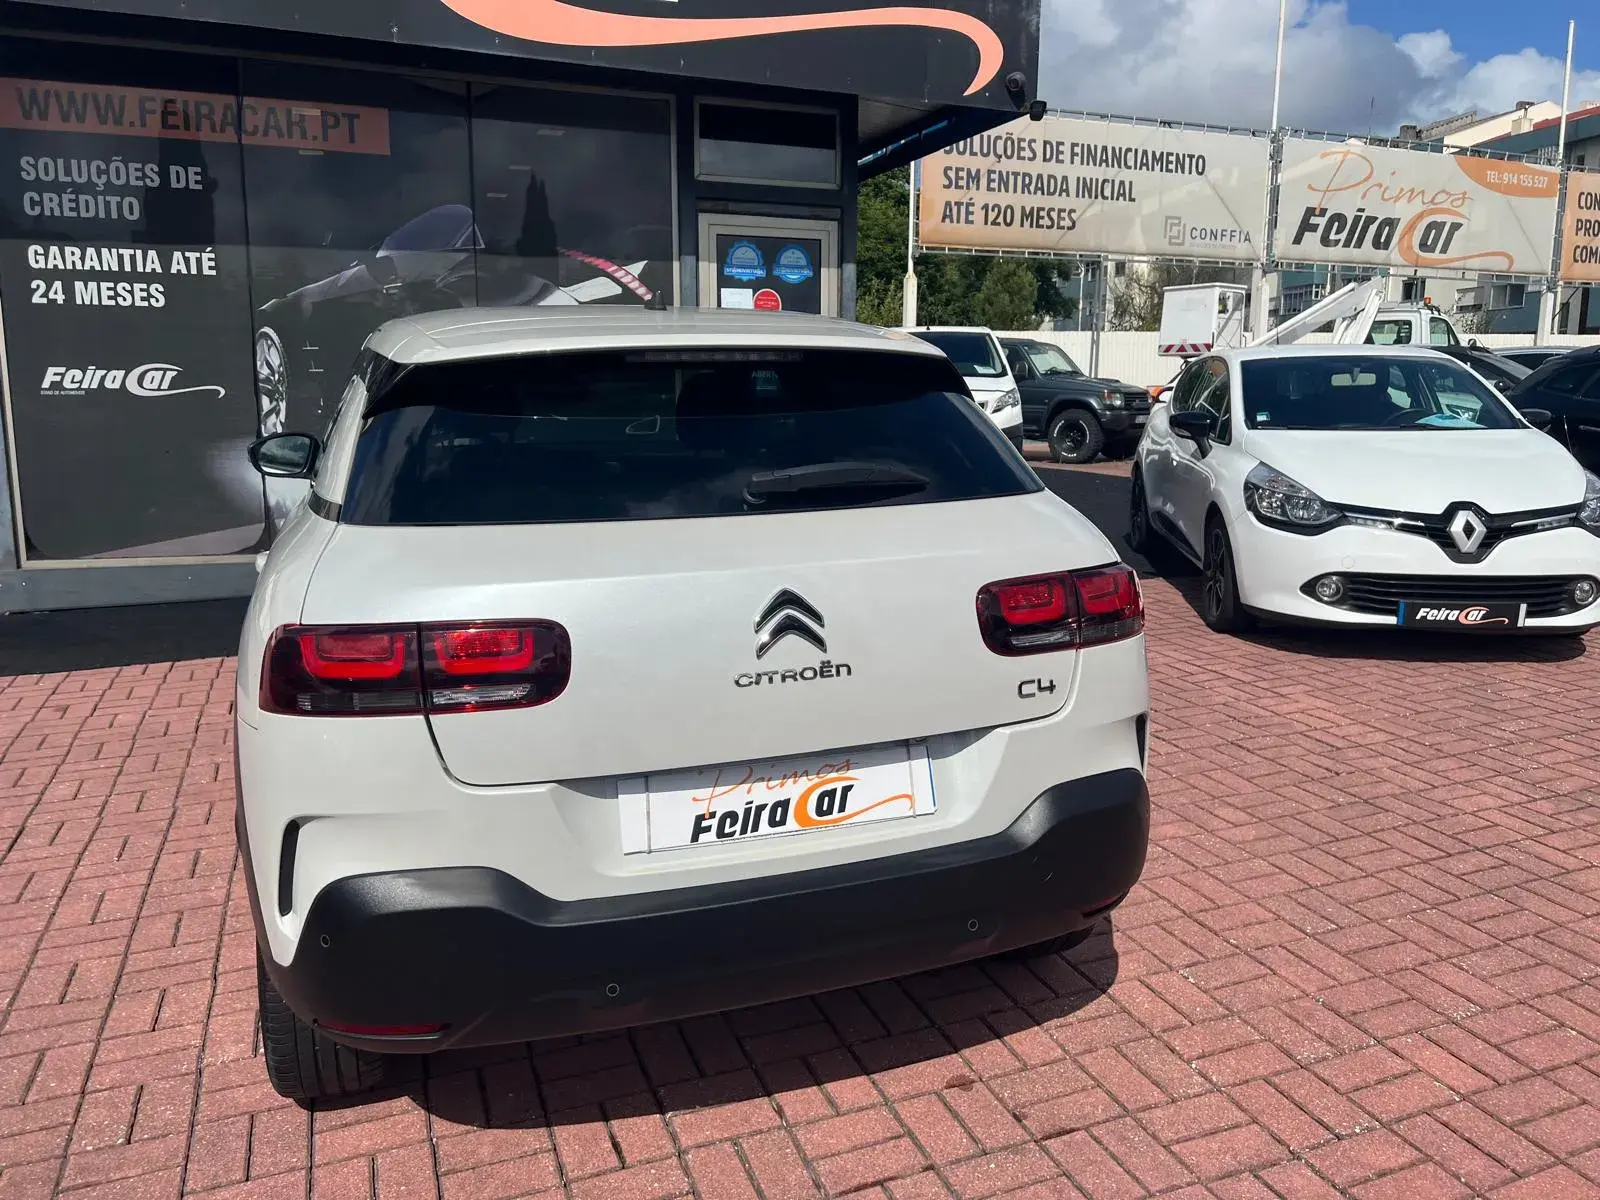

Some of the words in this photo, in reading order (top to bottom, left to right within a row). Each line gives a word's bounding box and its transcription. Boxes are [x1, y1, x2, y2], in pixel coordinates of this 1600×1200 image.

[17, 86, 361, 144] WWW.FEIRACAR.PT
[20, 156, 161, 190] SOLUÇÕES
[170, 165, 203, 190] DE
[1043, 140, 1065, 165] DE
[1070, 142, 1206, 176] FINANCIAMENTO
[943, 166, 981, 191] SEM
[986, 171, 1070, 198] ENTRADA
[1075, 177, 1136, 203] INICIAL
[24, 188, 140, 221] CRÉDITO
[941, 197, 974, 225] ATÉ
[981, 203, 1015, 228] 120
[1020, 206, 1077, 231] MESES
[1190, 227, 1252, 243] CONFFIA
[1292, 206, 1471, 267] FeiraCar
[28, 244, 163, 274] GARANTIA
[170, 247, 217, 276] ATÉ
[1573, 244, 1600, 264] COM
[31, 280, 66, 305] 24
[75, 281, 166, 307] MESES
[41, 363, 184, 396] FeiraCar
[1416, 606, 1490, 625] FeiraCar
[1017, 678, 1056, 699] C4
[690, 776, 860, 843] FeiraCar
